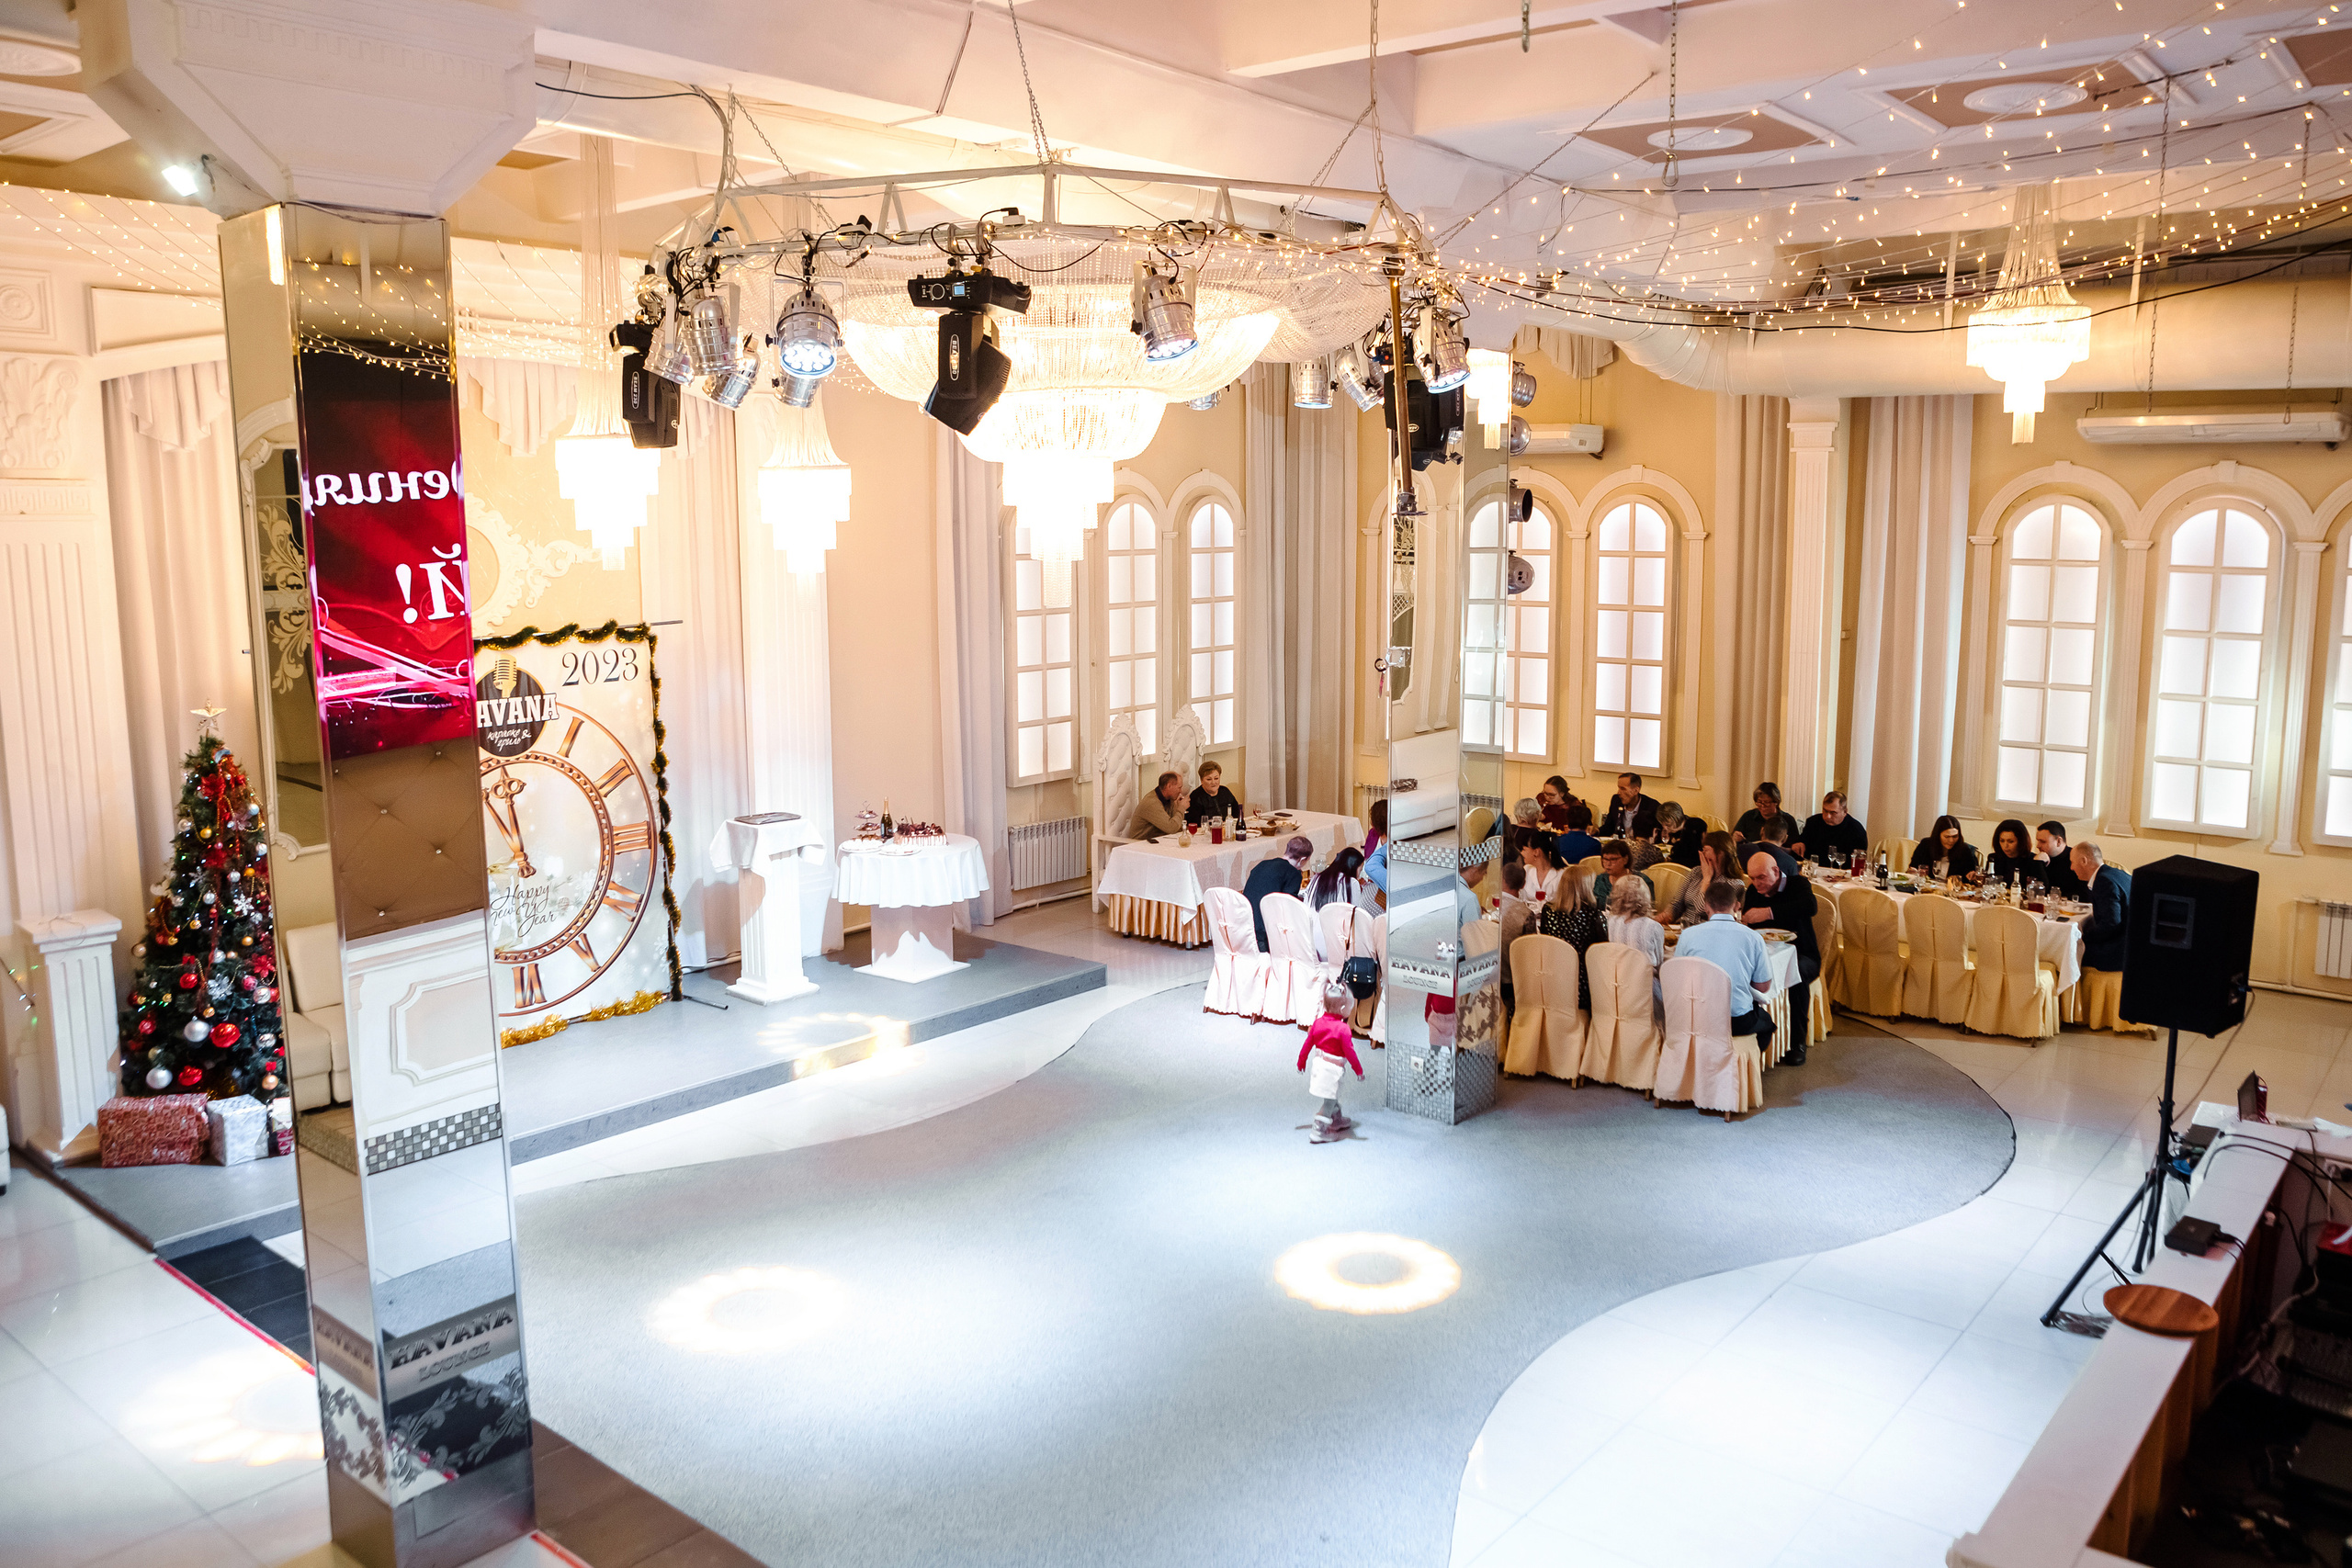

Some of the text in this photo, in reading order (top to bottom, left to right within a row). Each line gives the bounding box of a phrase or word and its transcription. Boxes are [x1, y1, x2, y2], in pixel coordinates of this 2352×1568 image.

[561, 648, 639, 686] 2023
[476, 693, 560, 728] AVANA
[487, 728, 520, 743] караоке
[497, 736, 521, 751] гриль
[491, 884, 549, 913] Happy
[516, 902, 556, 937] Year
[1391, 957, 1451, 978] HAVANA
[1458, 955, 1498, 978] HAVANA
[390, 1309, 514, 1370] HAVANA
[418, 1340, 492, 1382] LOUNGE
